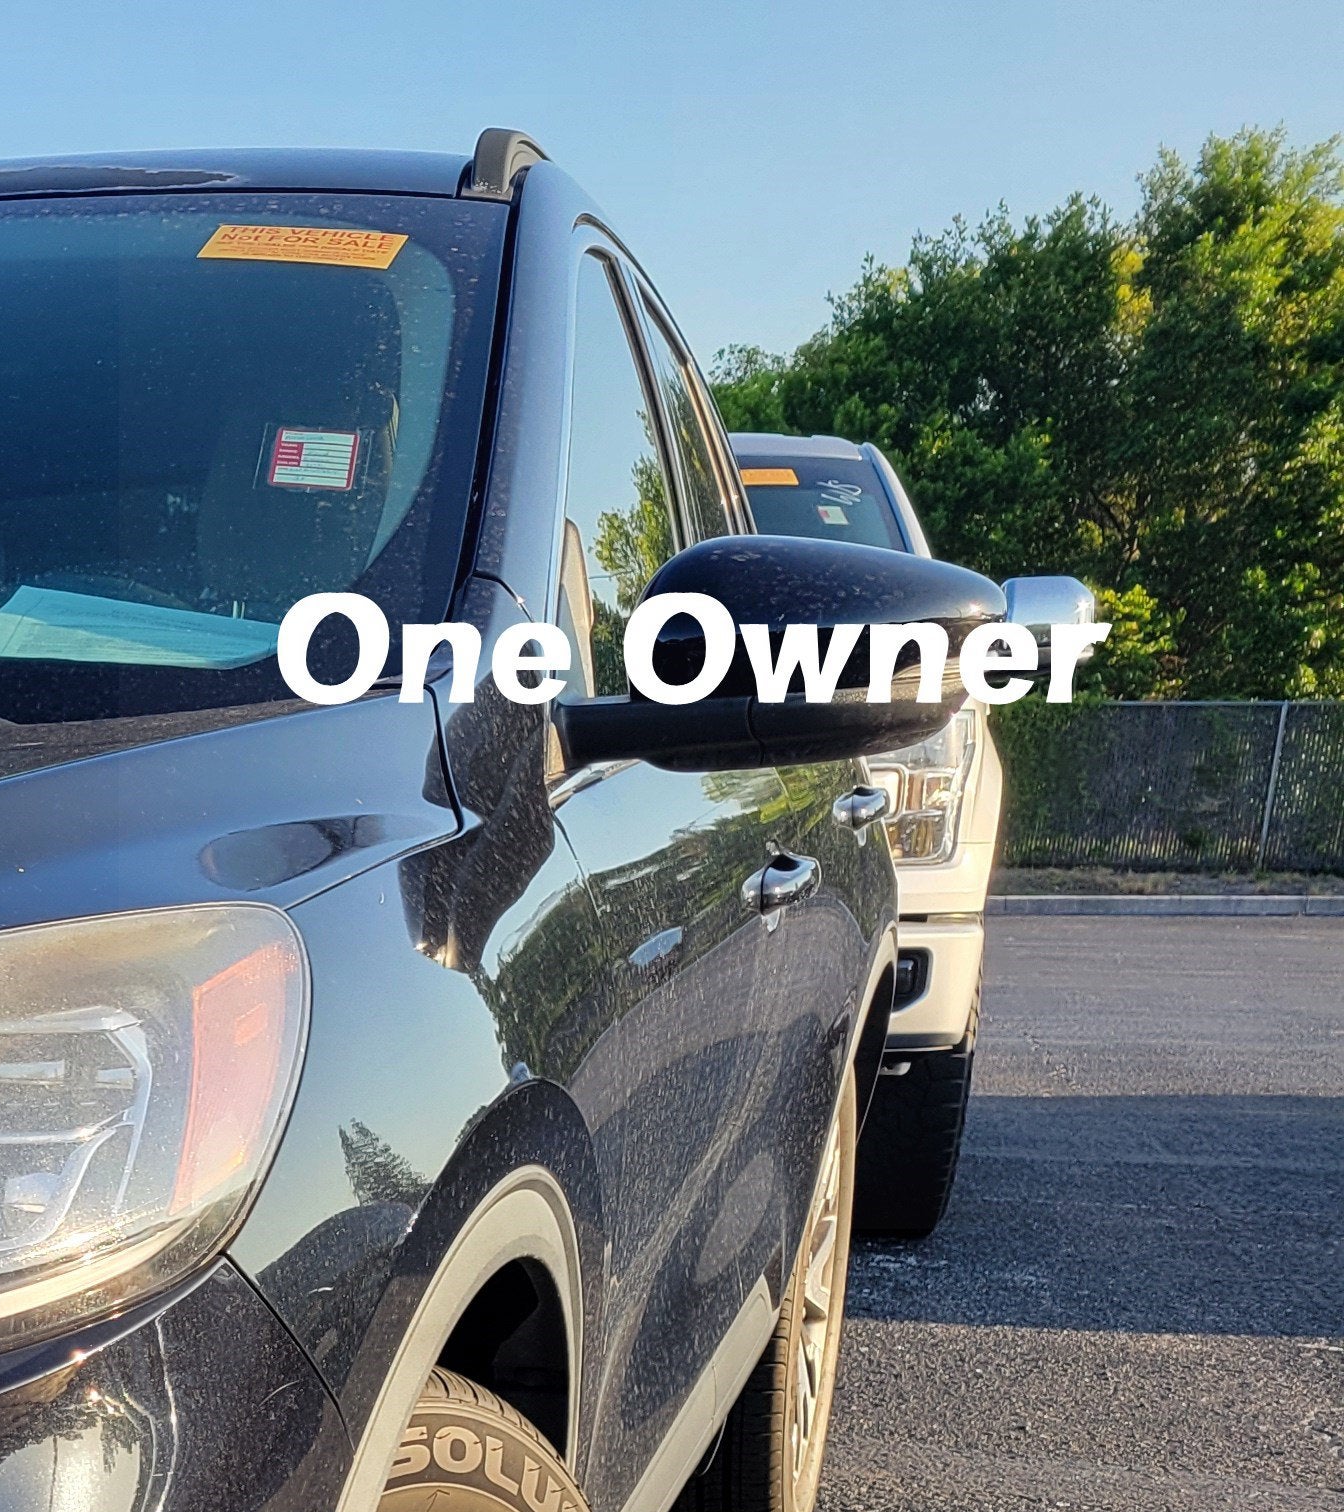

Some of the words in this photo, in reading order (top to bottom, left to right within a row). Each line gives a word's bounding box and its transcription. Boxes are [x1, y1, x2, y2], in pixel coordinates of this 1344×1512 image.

[229, 226, 281, 235] THIS
[290, 228, 394, 242] VEHICLE
[267, 235, 320, 245] FOR
[327, 238, 394, 250] SALE
